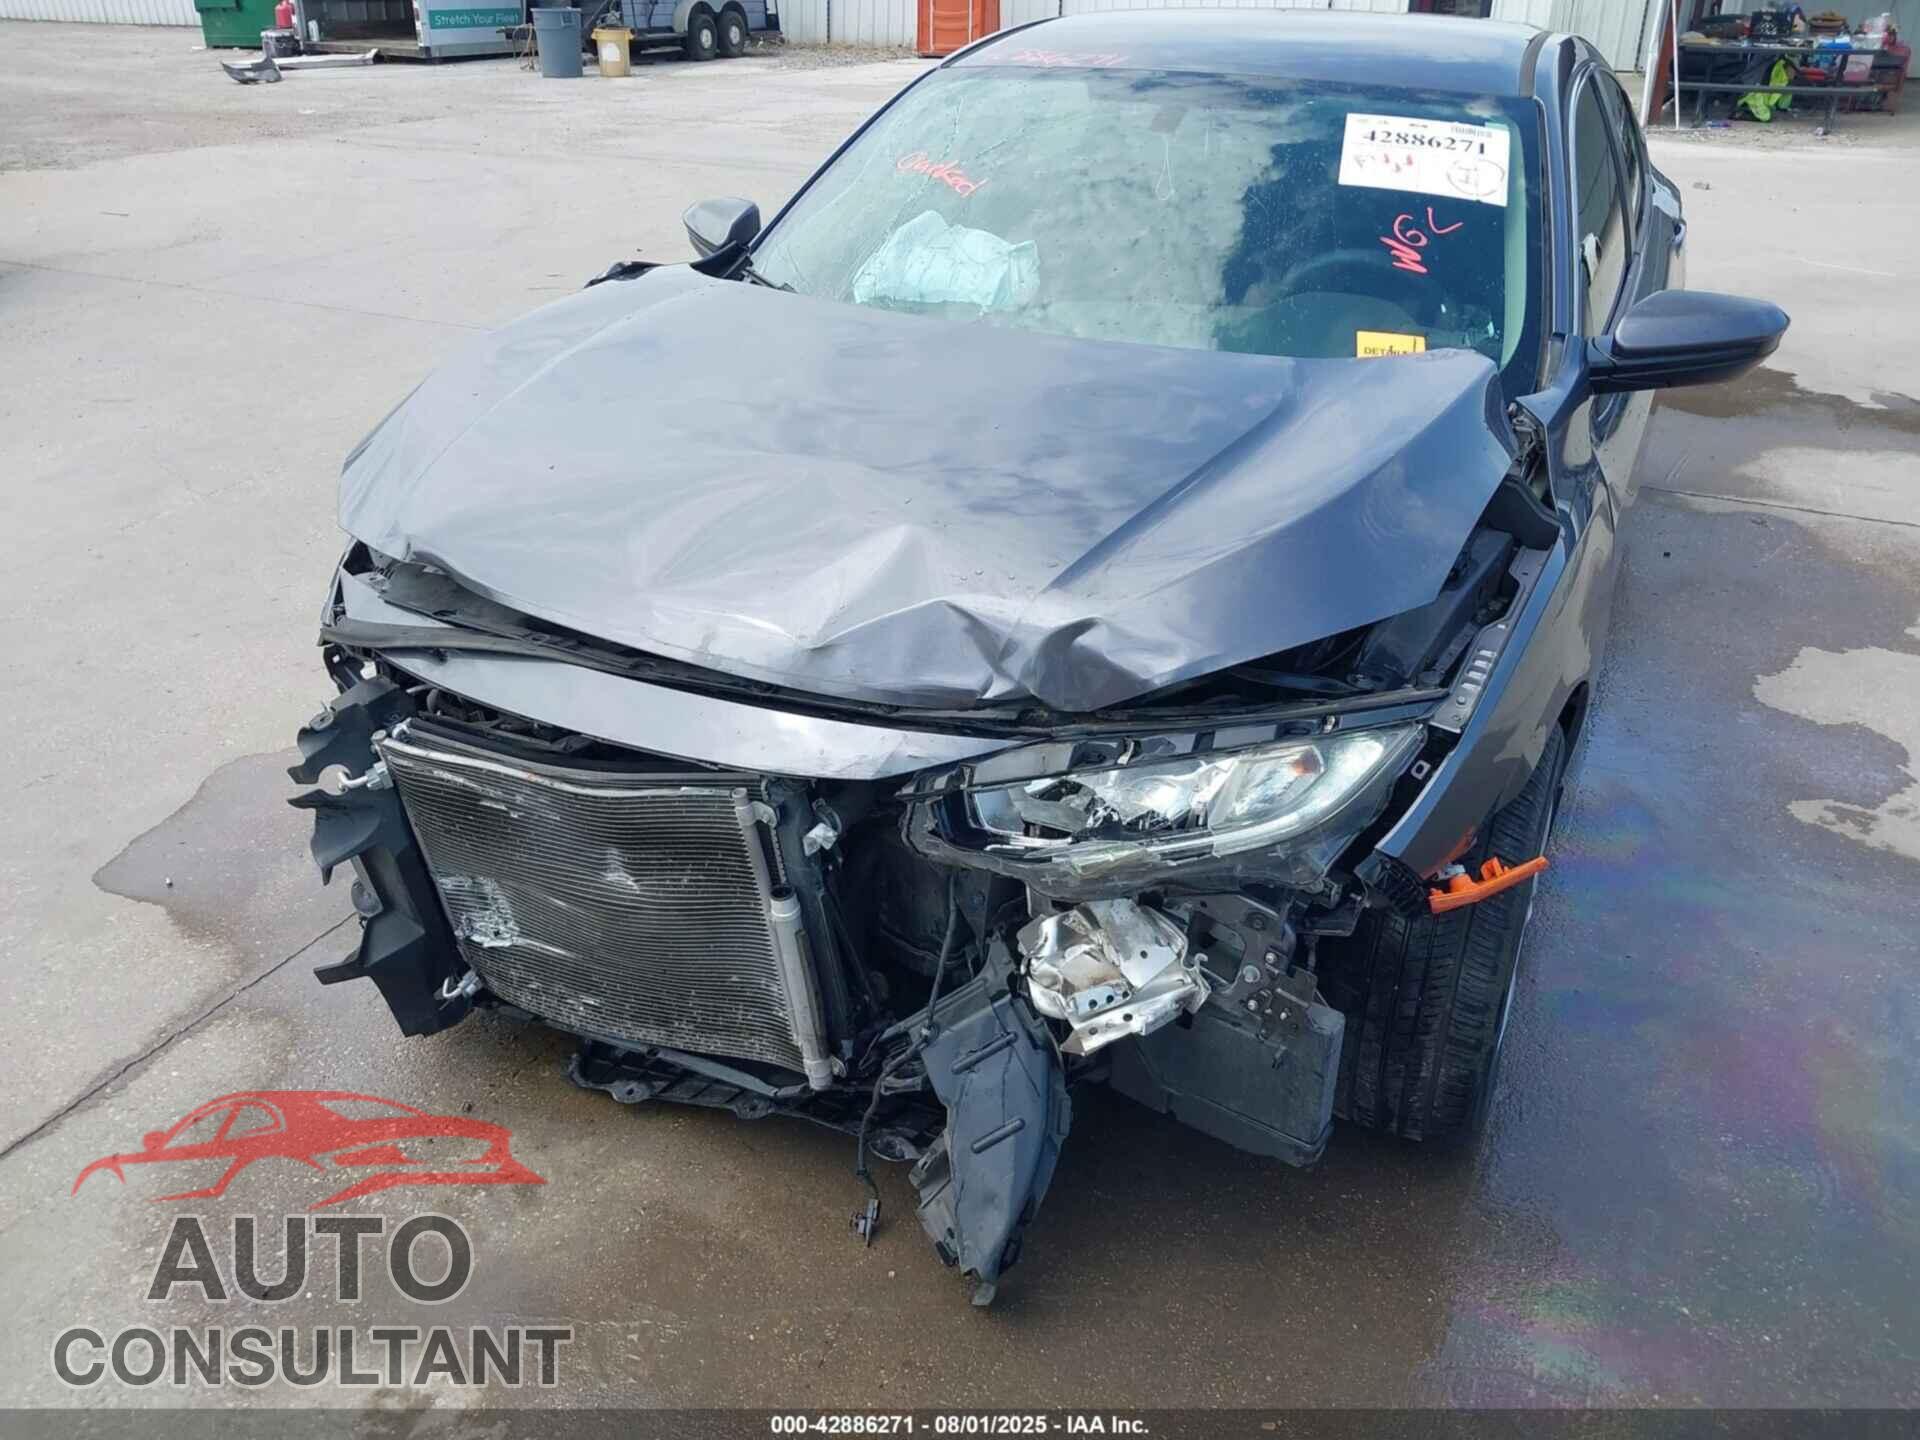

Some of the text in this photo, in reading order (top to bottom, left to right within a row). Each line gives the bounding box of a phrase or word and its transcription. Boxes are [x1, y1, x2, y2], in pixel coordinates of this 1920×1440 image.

[434, 14, 471, 26] Stretch
[472, 13, 494, 25] Your
[1362, 129, 1486, 155] 42886271
